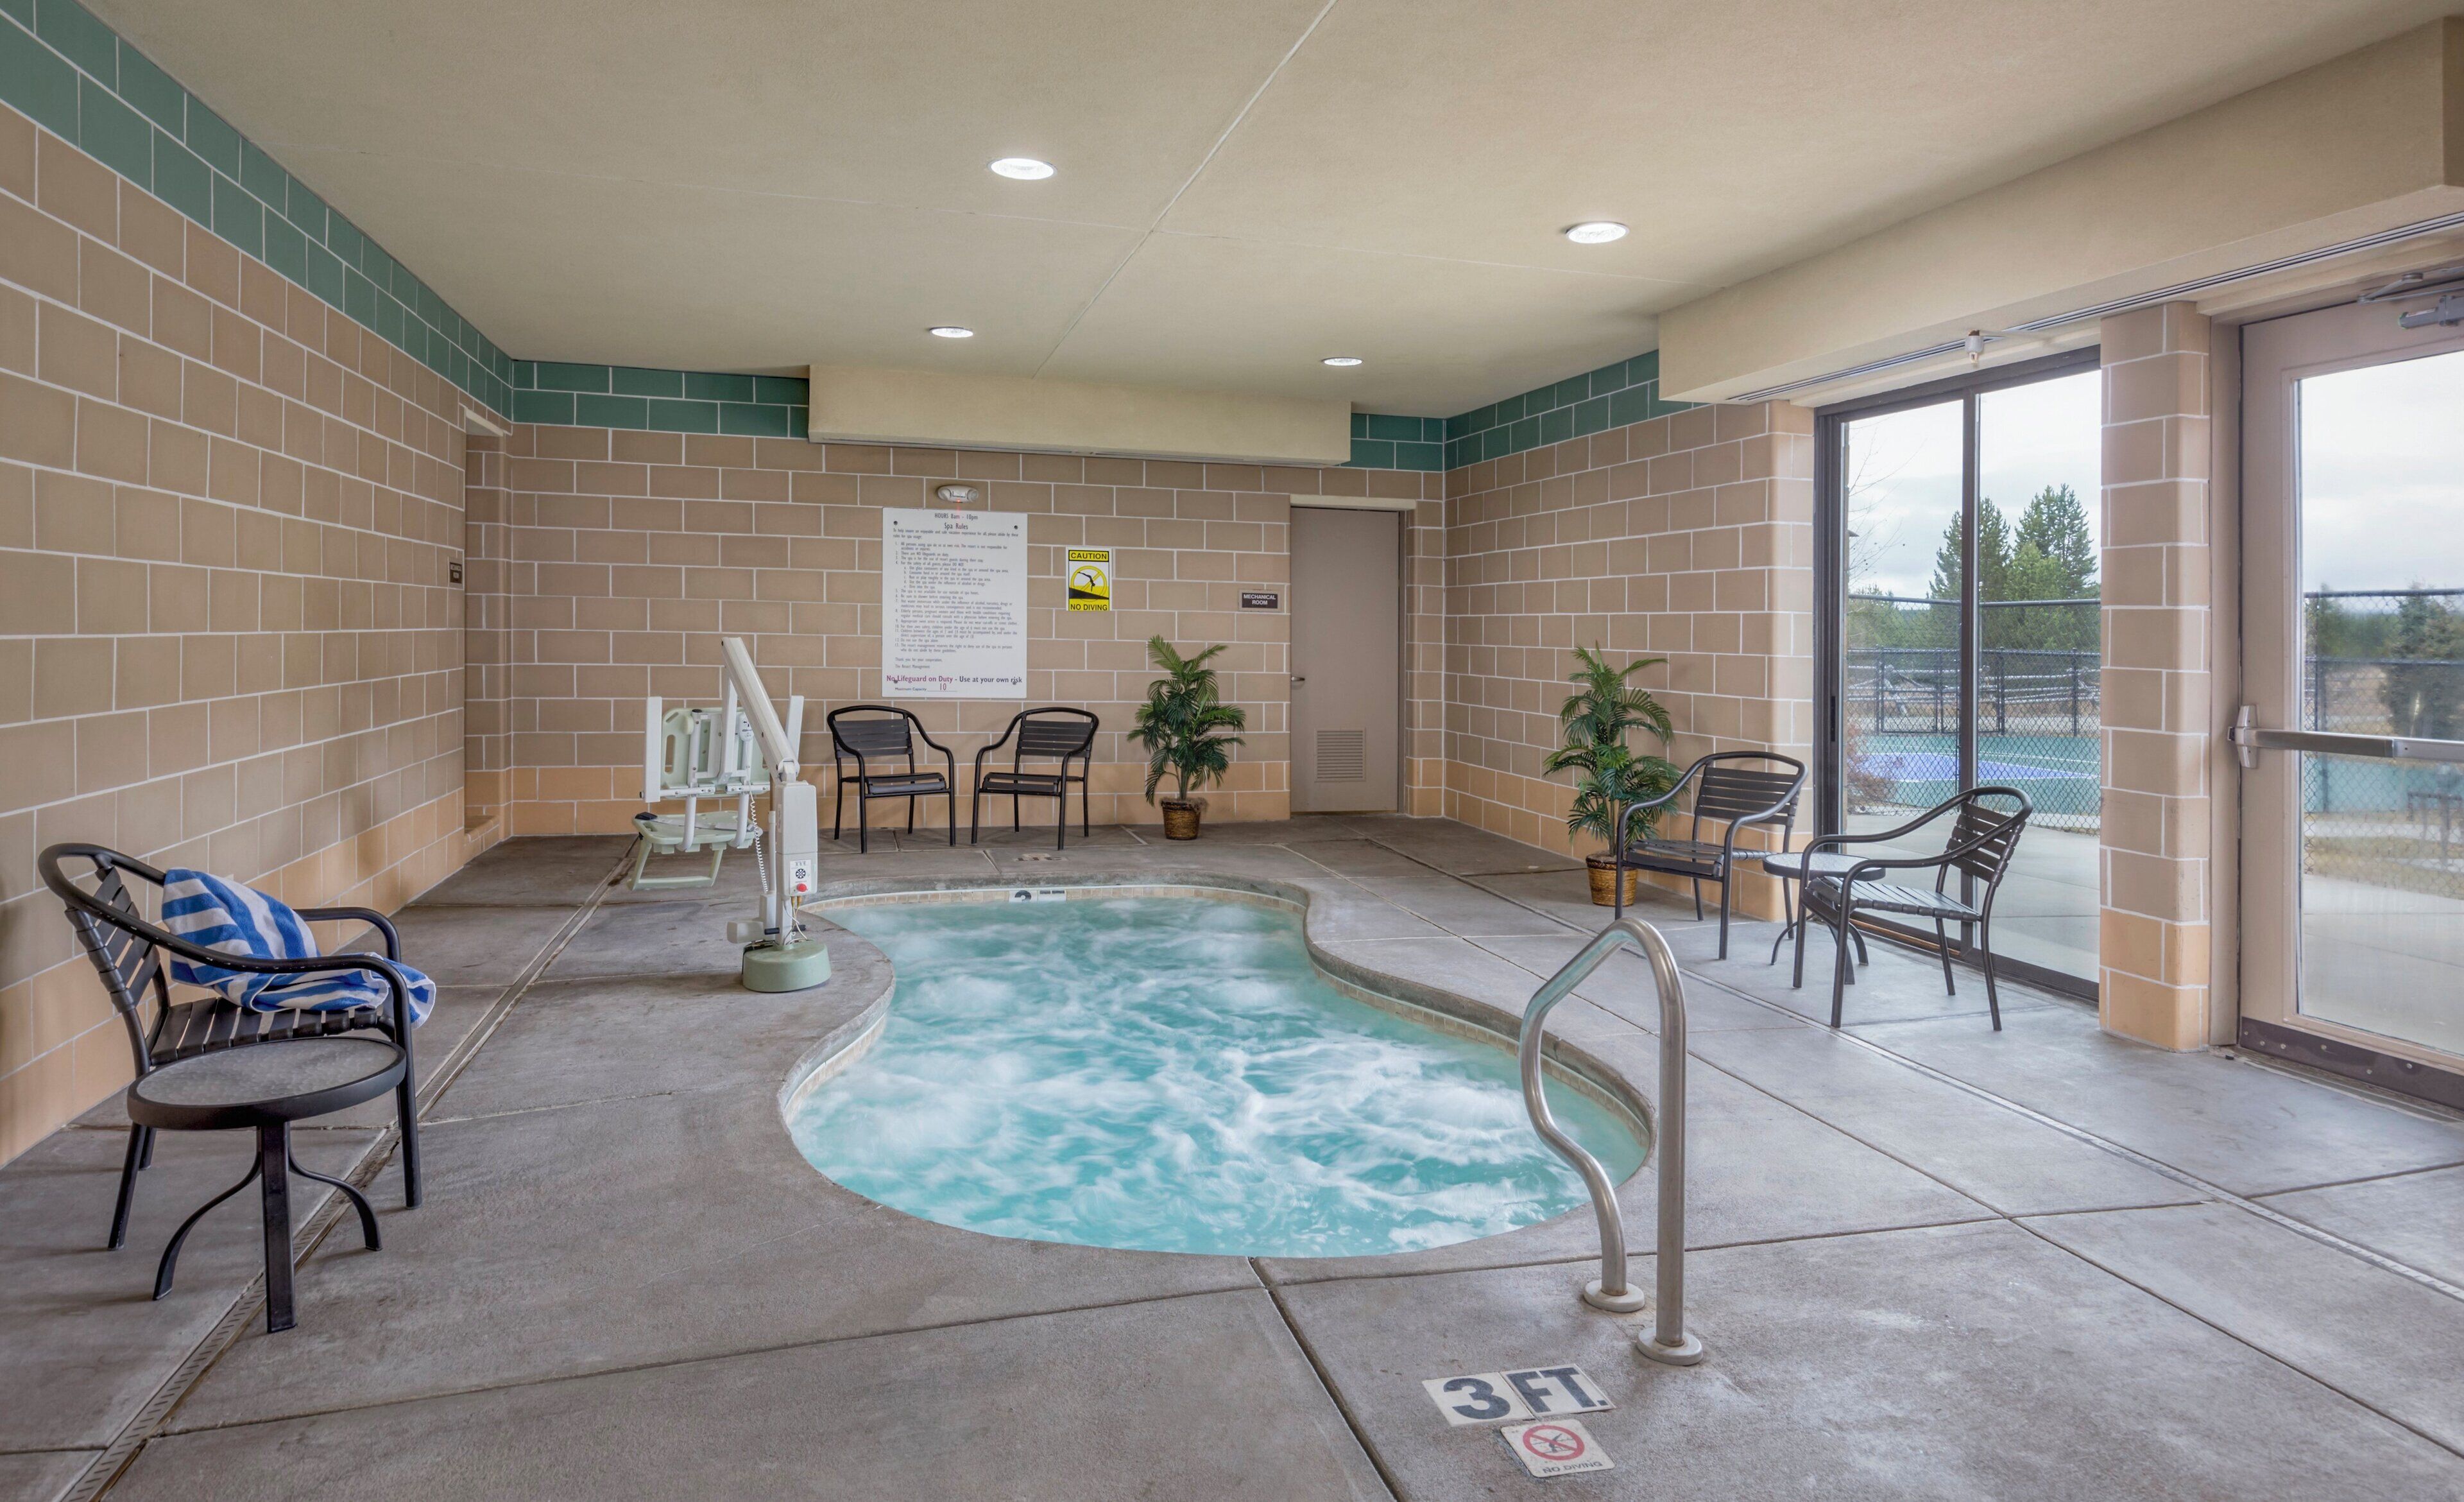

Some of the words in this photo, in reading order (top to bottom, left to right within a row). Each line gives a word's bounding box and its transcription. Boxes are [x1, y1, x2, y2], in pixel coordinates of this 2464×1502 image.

[898, 675, 927, 684] Lifeguard
[1443, 1377, 1510, 1419] 3
[1506, 1367, 1609, 1412] FT.
[1564, 1462, 1603, 1470] DIVING
